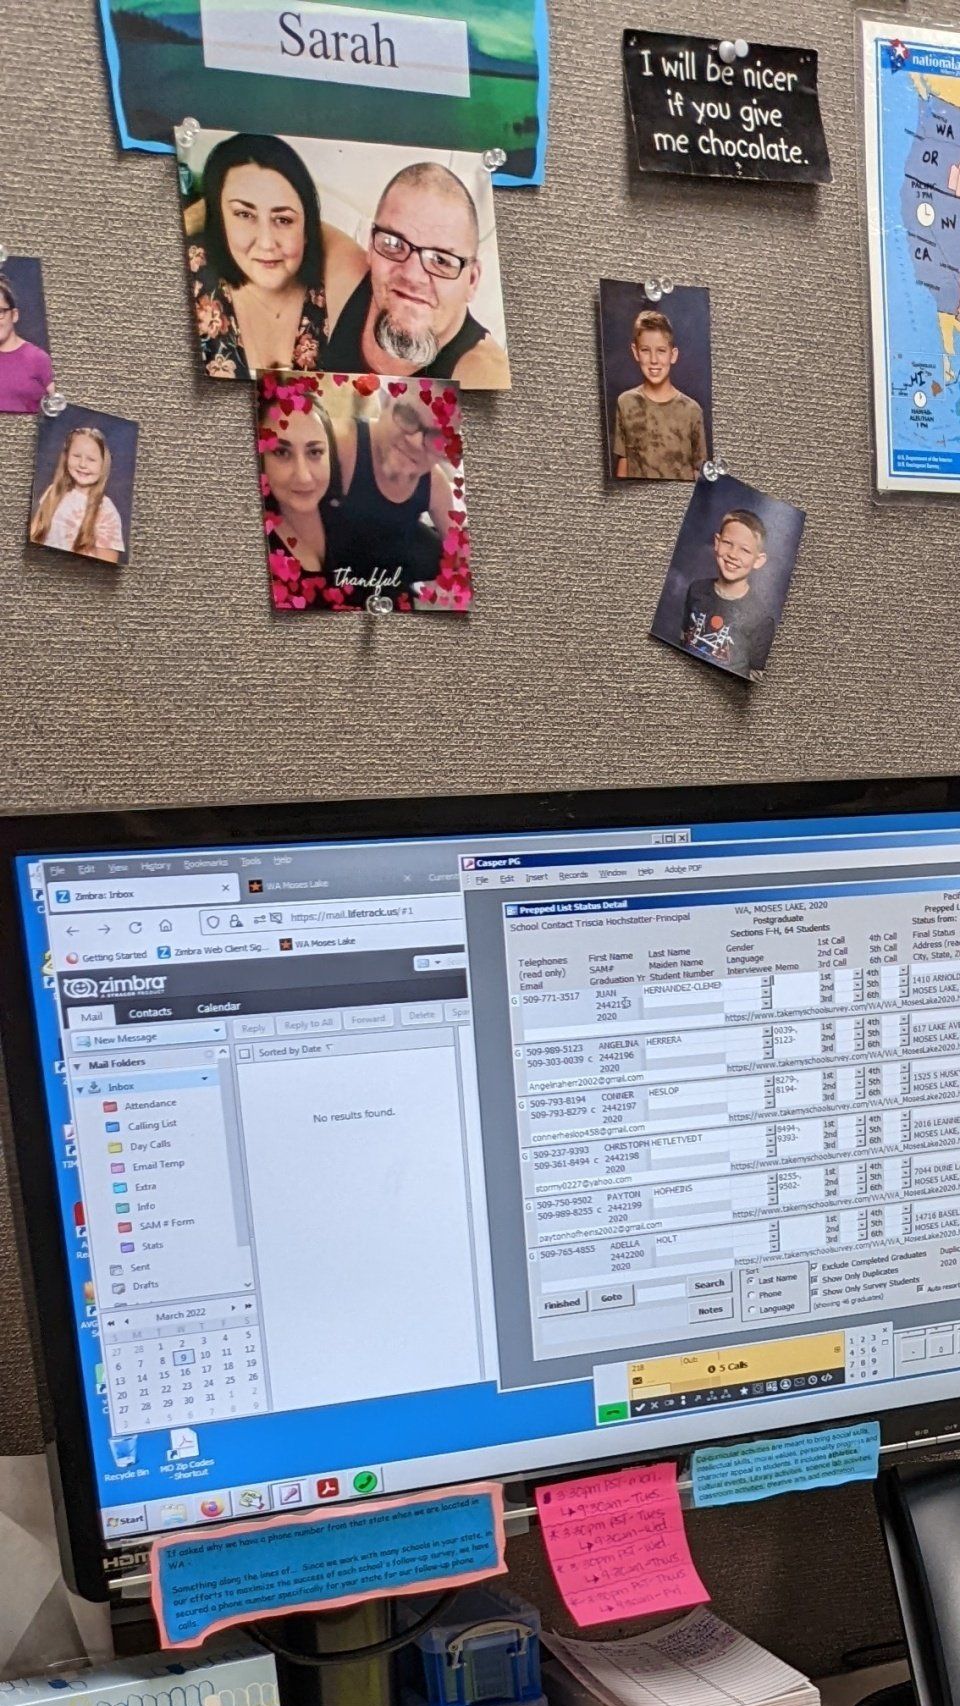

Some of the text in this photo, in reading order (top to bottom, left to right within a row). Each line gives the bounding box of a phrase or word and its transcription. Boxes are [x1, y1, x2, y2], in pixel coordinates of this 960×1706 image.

[279, 12, 399, 68] Sarah
[641, 51, 798, 92] I will be nicer
[667, 89, 782, 131] if you give
[936, 124, 954, 140] WA
[654, 129, 808, 165] me chocolate.
[923, 151, 939, 166] OR
[941, 214, 957, 229] NV
[915, 248, 932, 261] CA
[79, 858, 228, 875] Edit History Bookmarks
[476, 857, 521, 869] Casper PG
[75, 890, 134, 901] Zimbra: Inbox
[520, 900, 628, 916] Prepped List Status Detail
[752, 913, 804, 925] Postgraduate
[726, 943, 754, 953] Gender
[83, 951, 147, 963] Getting Started
[518, 955, 568, 968] Telephones
[726, 954, 764, 965] Language
[649, 969, 714, 982] Student Number
[99, 975, 167, 993] zimbra
[520, 982, 543, 991] Email
[81, 1001, 241, 1022] Mail Contacts Calendar
[95, 1033, 157, 1045] New Message
[125, 1099, 177, 1110] Attendance
[313, 1108, 395, 1123] No results found.
[128, 1120, 177, 1131] Calling List
[131, 1140, 171, 1152] Day Calls
[136, 1183, 157, 1191] Extra
[138, 1203, 155, 1211] Info
[545, 1279, 725, 1310] Finished Goto Search
[156, 1308, 206, 1322] March 2022
[698, 1305, 723, 1315] Notes
[120, 1515, 144, 1525] Start
